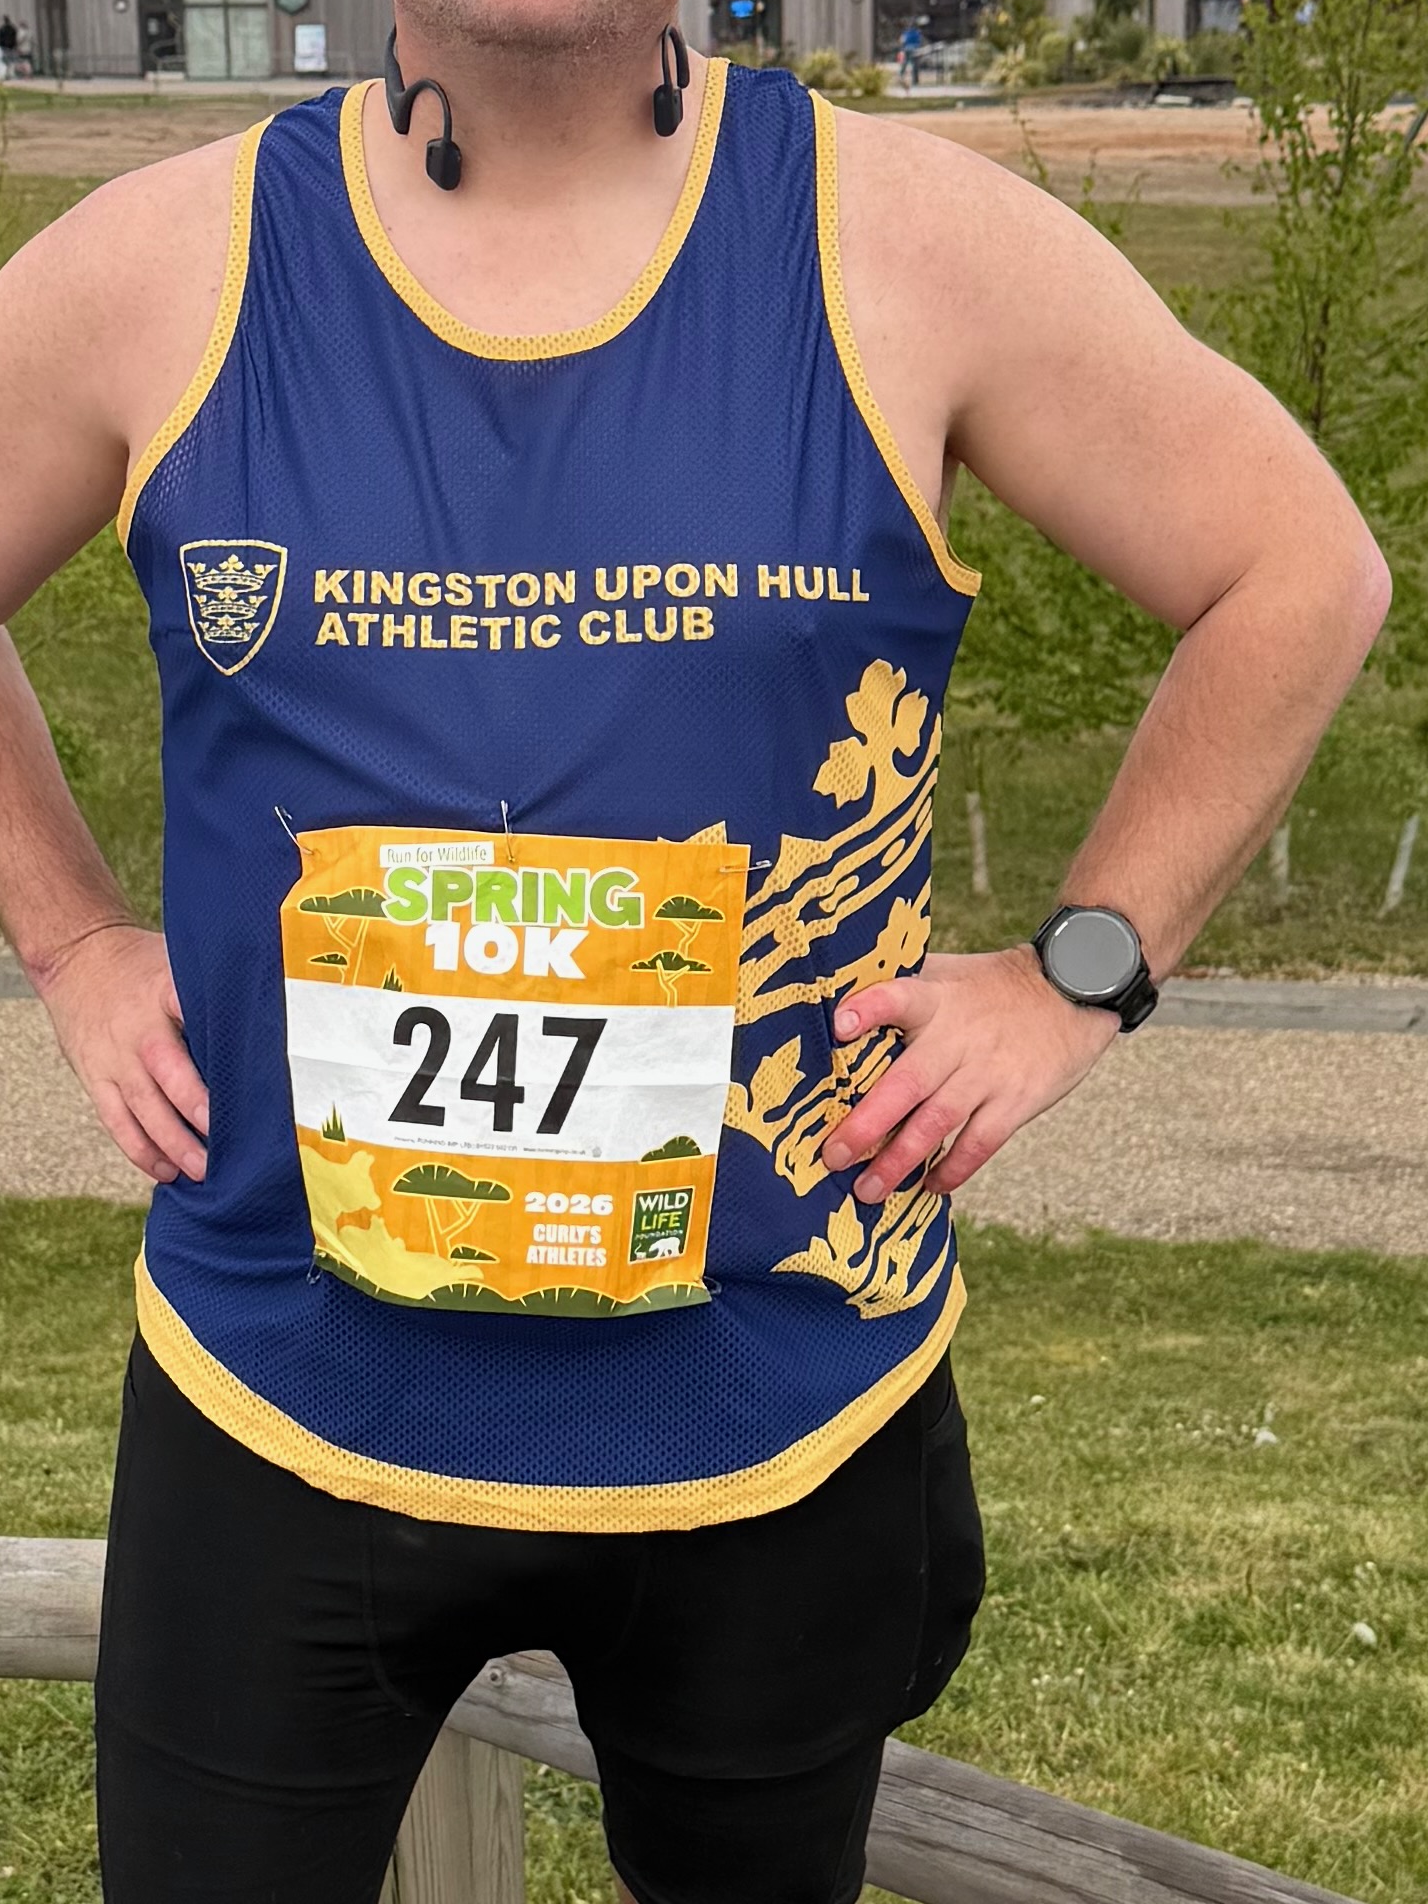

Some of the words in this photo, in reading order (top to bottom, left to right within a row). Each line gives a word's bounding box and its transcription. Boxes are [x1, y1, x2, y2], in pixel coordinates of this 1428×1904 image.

[313, 567, 577, 609] KINGSTON
[595, 562, 739, 601] UPON
[758, 564, 871, 603] HULL
[315, 612, 562, 651] ATHLETIC
[579, 606, 715, 647] CLUB
[387, 849, 412, 864] Run
[416, 847, 433, 863] for
[437, 845, 487, 862] Wildlife
[383, 866, 645, 928] SPRING
[425, 923, 590, 979] 10K
[387, 1005, 608, 1135] 247
[524, 1191, 614, 1216] 2026
[638, 1192, 689, 1212] WILD
[533, 1223, 602, 1244] CURLY'S
[641, 1212, 683, 1231] LIFE
[526, 1245, 608, 1267] ATHLETES
